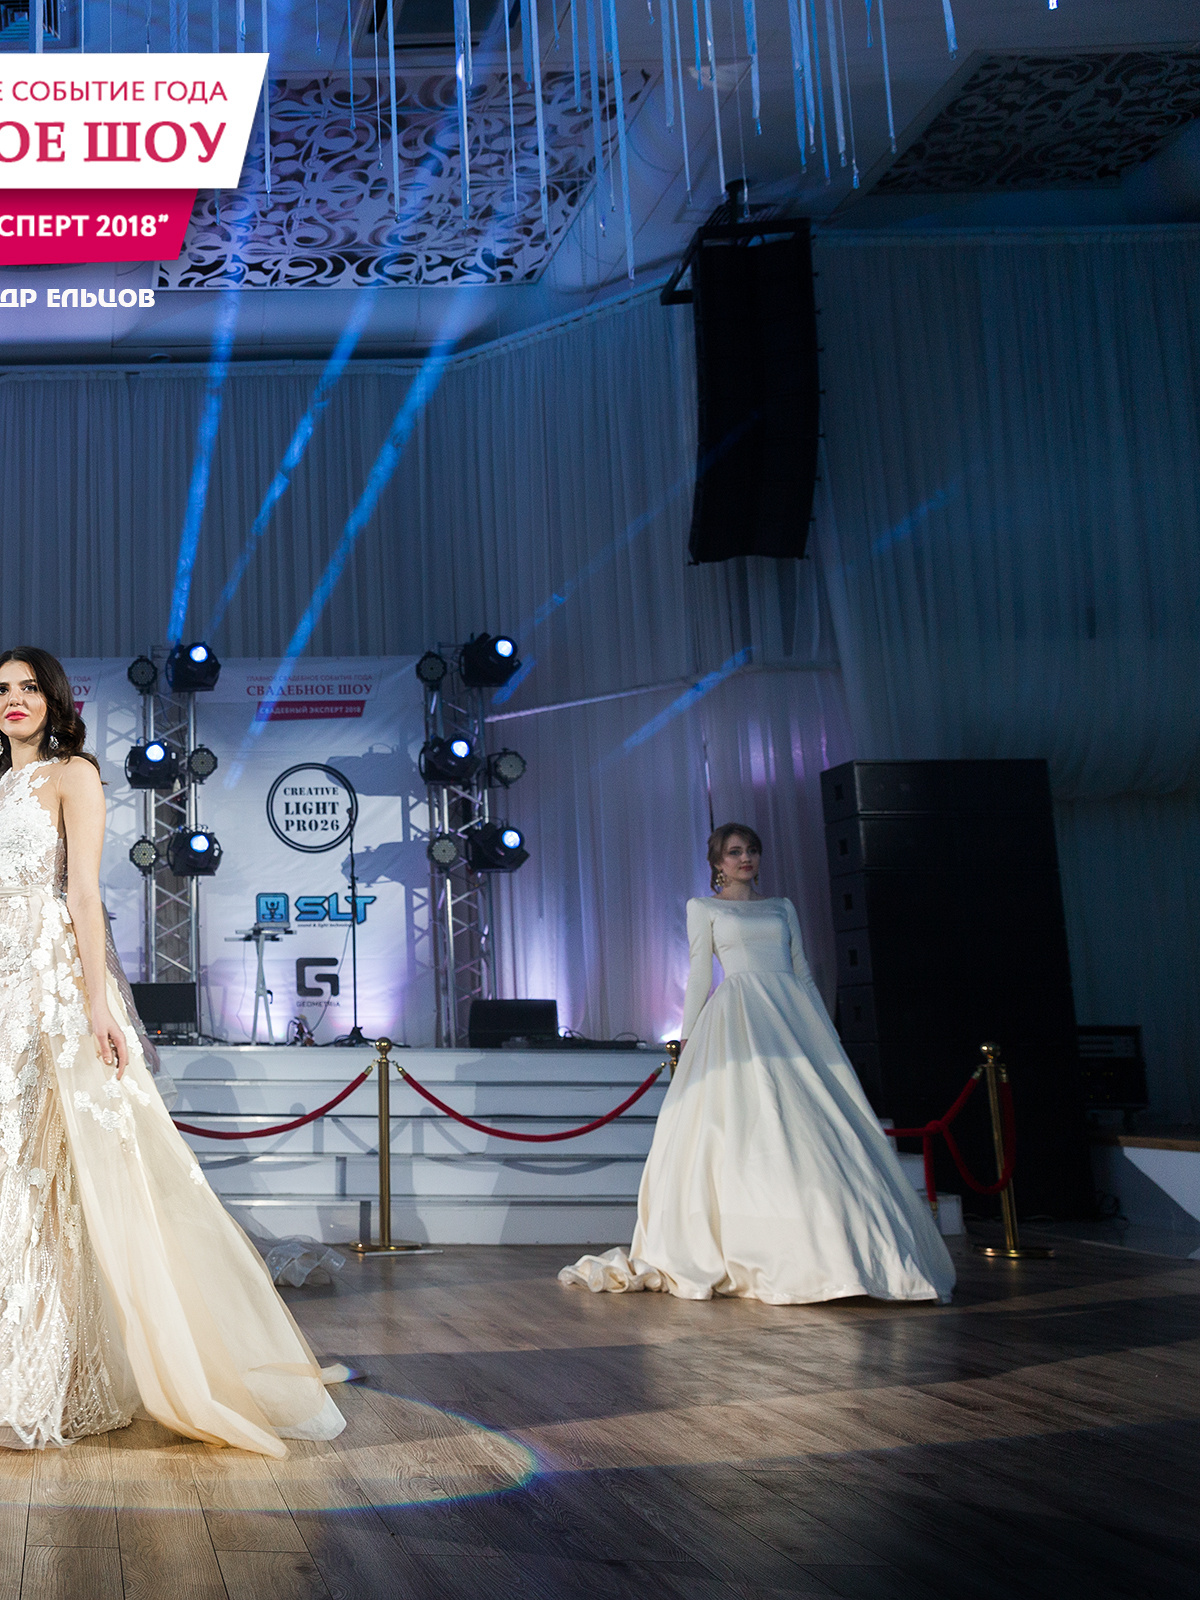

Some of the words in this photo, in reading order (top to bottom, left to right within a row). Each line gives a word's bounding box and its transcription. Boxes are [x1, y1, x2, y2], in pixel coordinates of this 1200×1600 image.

[69, 685, 92, 696] ОУ
[246, 684, 335, 697] СВАДЕБНОЕ
[338, 684, 373, 695] ШОУ
[309, 706, 343, 714] ЭКСПЕРТ
[283, 787, 339, 796] CREATIVE
[284, 801, 340, 816] LIGHT
[284, 819, 340, 832] PRO26
[294, 892, 377, 925] SLT
